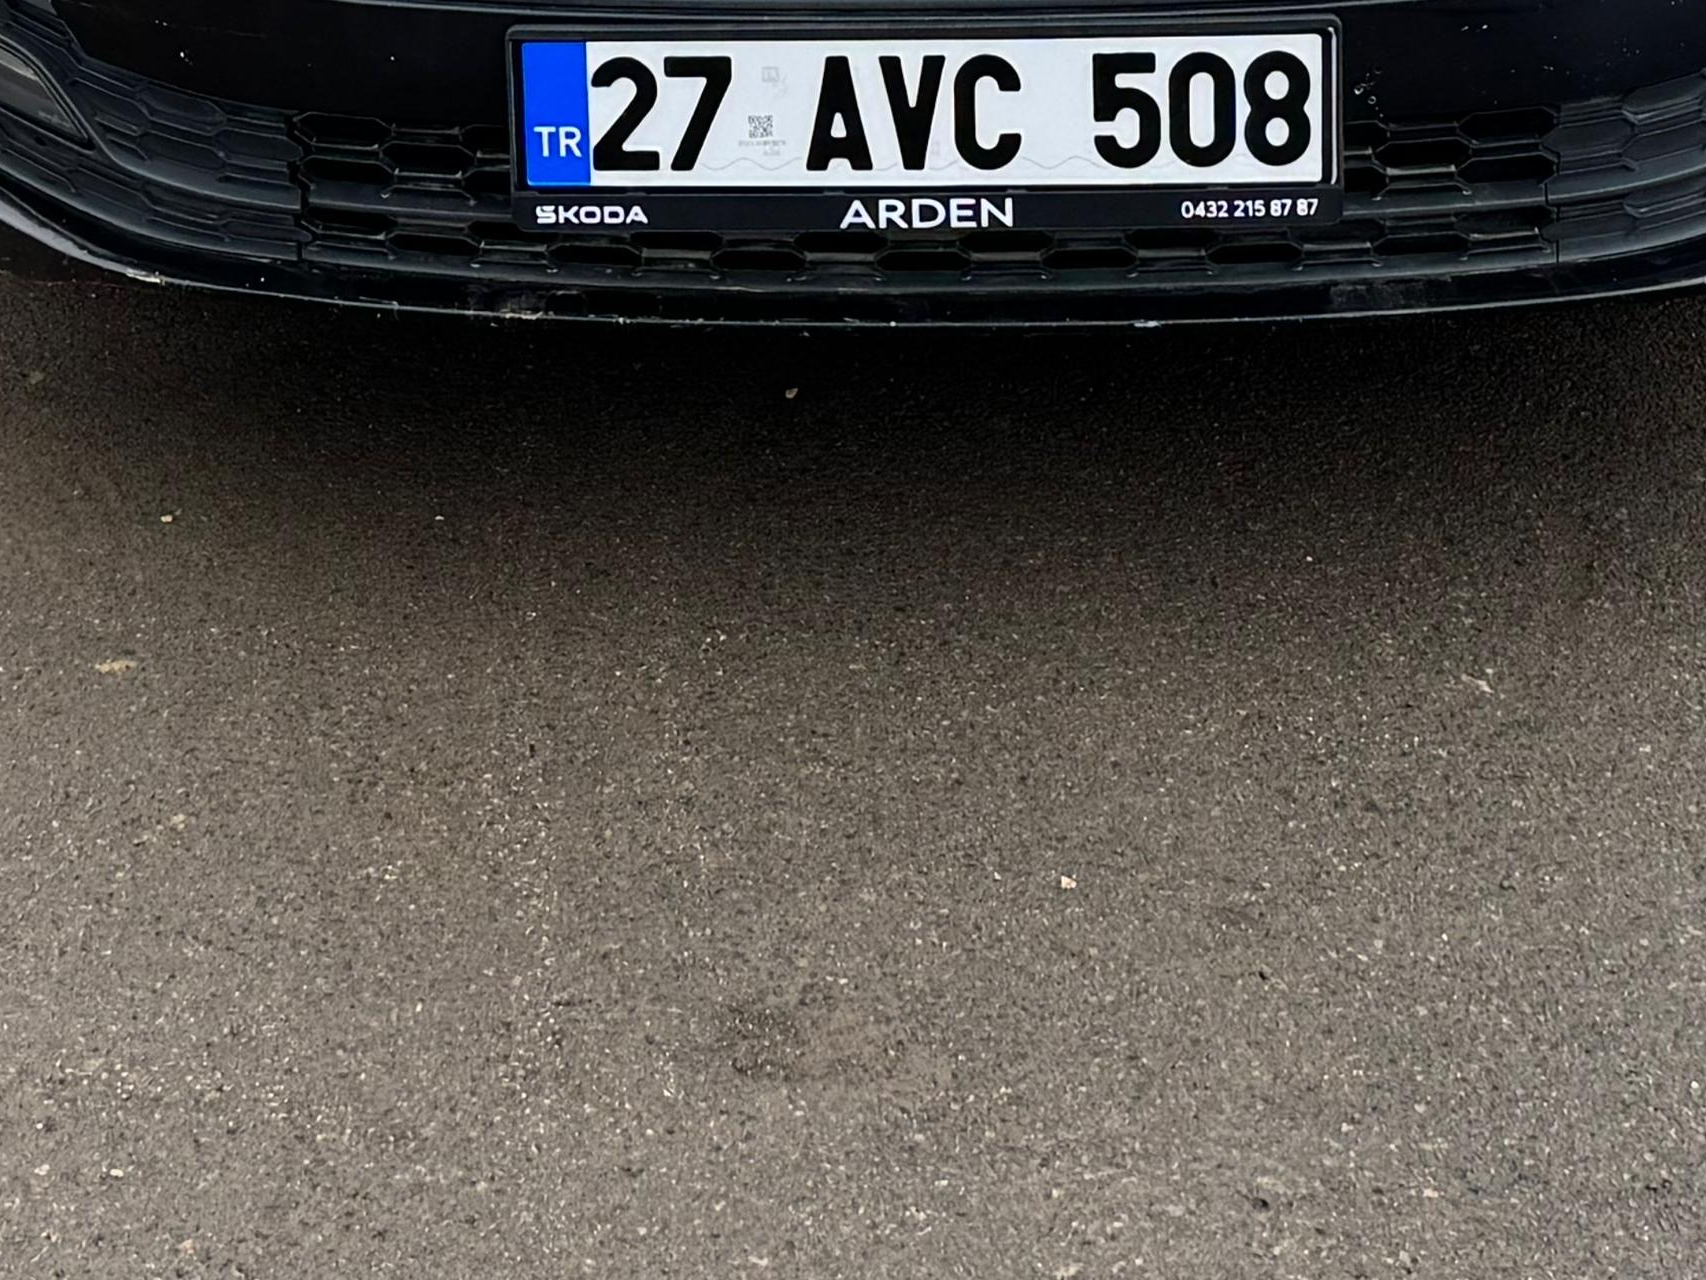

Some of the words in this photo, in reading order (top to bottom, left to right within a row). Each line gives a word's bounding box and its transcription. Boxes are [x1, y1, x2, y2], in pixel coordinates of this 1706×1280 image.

[590, 55, 732, 172] 27
[805, 54, 1022, 172] AVC
[1092, 50, 1311, 169] 508
[533, 125, 582, 158] TR
[839, 197, 1014, 229] ARDEN
[1180, 200, 1229, 219] 0432
[1233, 199, 1266, 217] 215
[1269, 198, 1293, 217] 87
[1296, 198, 1319, 216] 87
